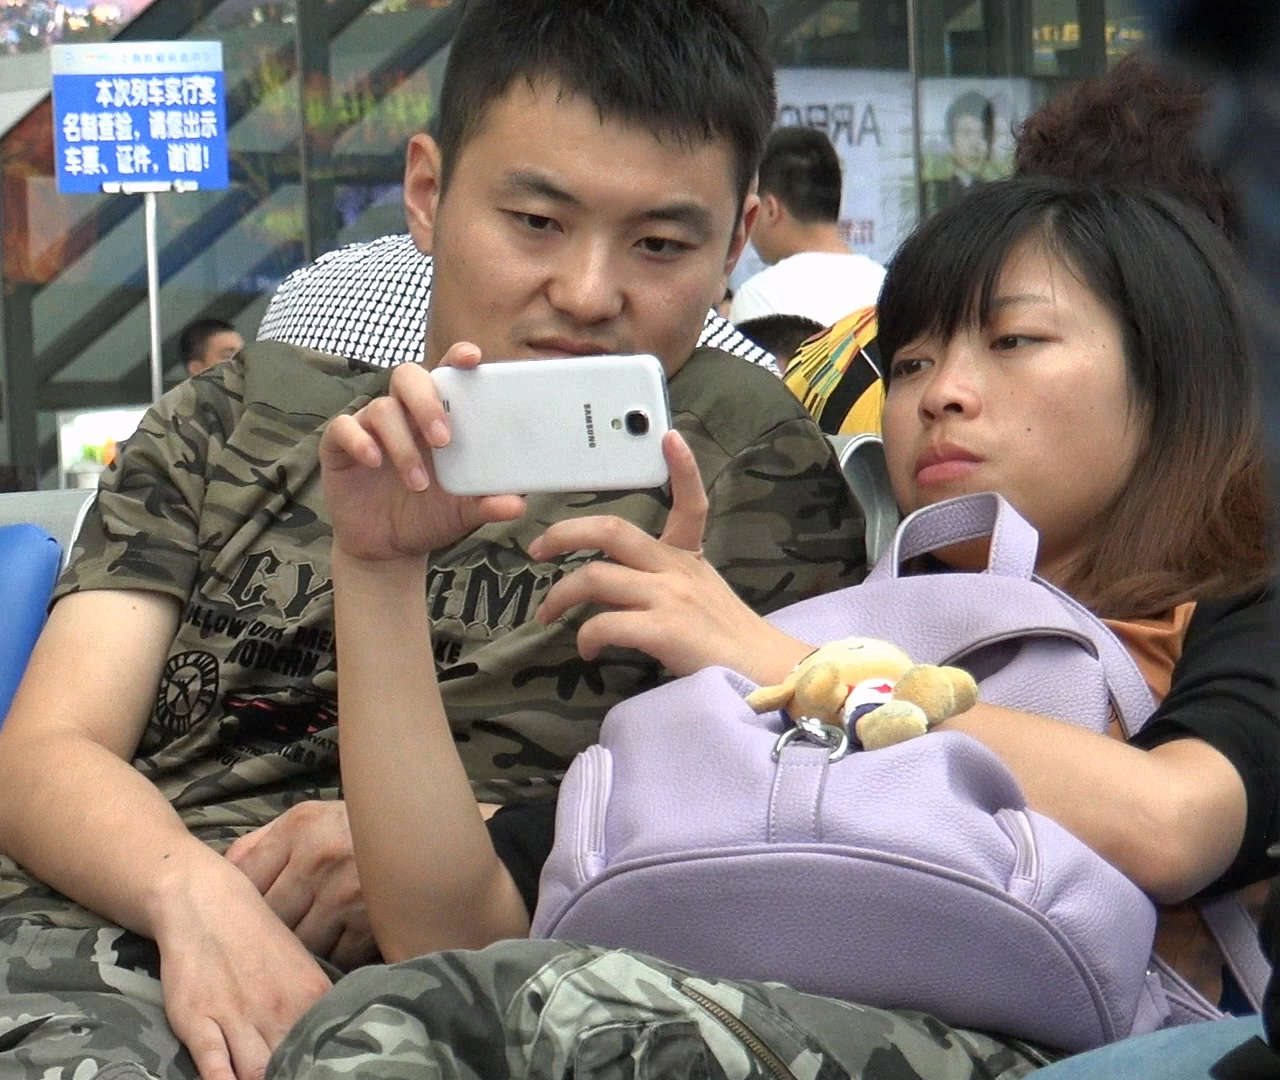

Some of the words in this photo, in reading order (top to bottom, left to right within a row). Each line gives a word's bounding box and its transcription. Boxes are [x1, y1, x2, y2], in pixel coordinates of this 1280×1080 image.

[95, 75, 217, 108] 本次列车实行实
[583, 403, 597, 449] SAMSUNG
